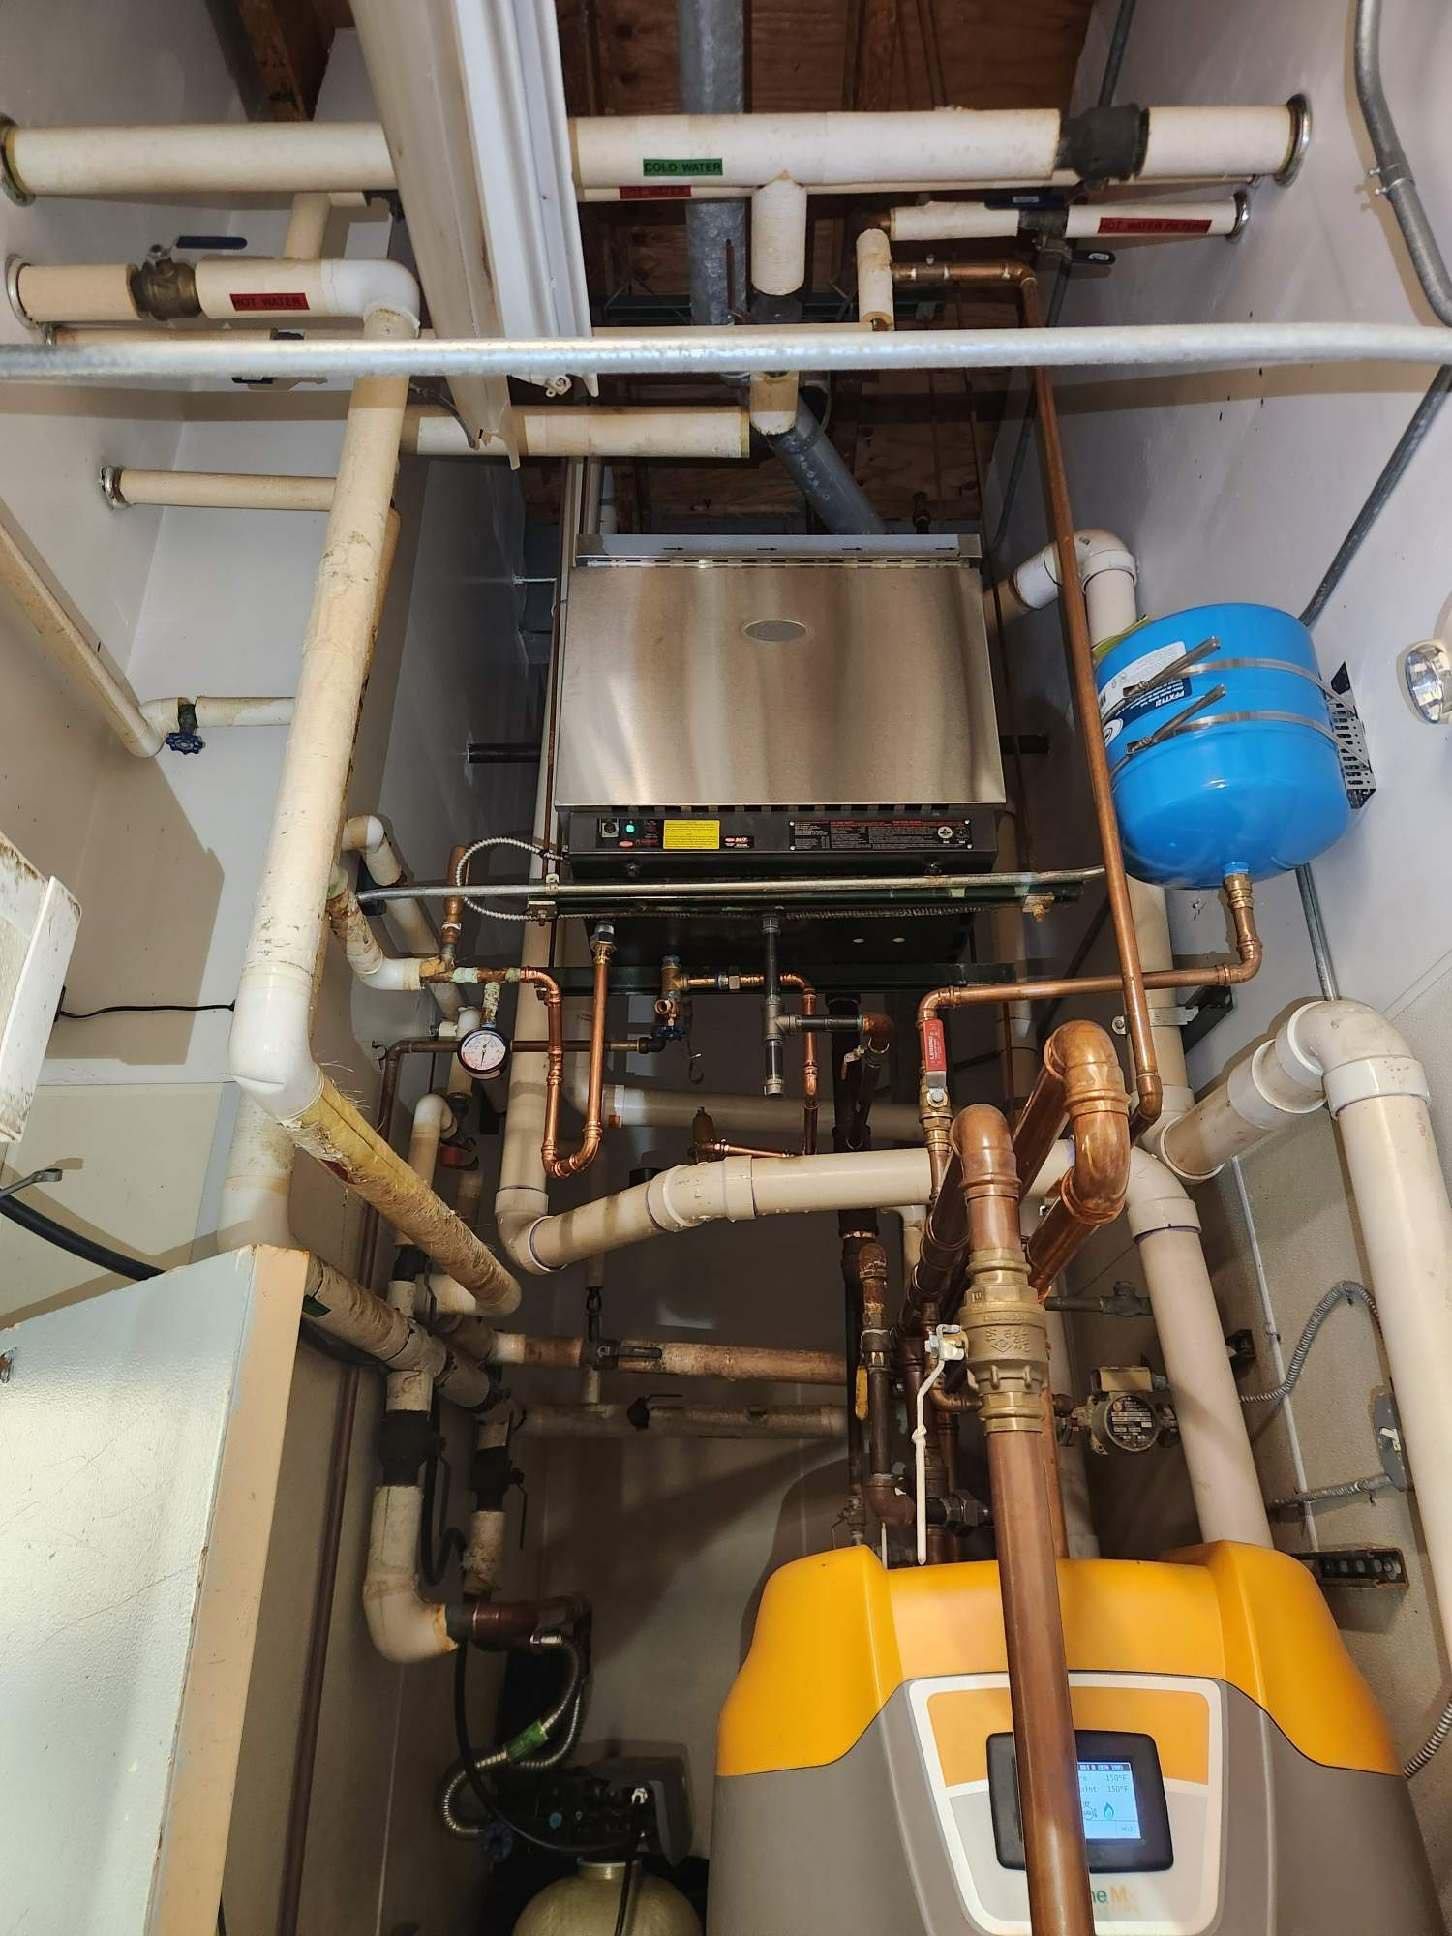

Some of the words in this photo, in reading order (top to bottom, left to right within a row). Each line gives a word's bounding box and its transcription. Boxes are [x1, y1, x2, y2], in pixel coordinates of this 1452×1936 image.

[644, 162, 678, 173] COLD
[680, 161, 722, 173] WATER
[233, 297, 256, 307] HOT
